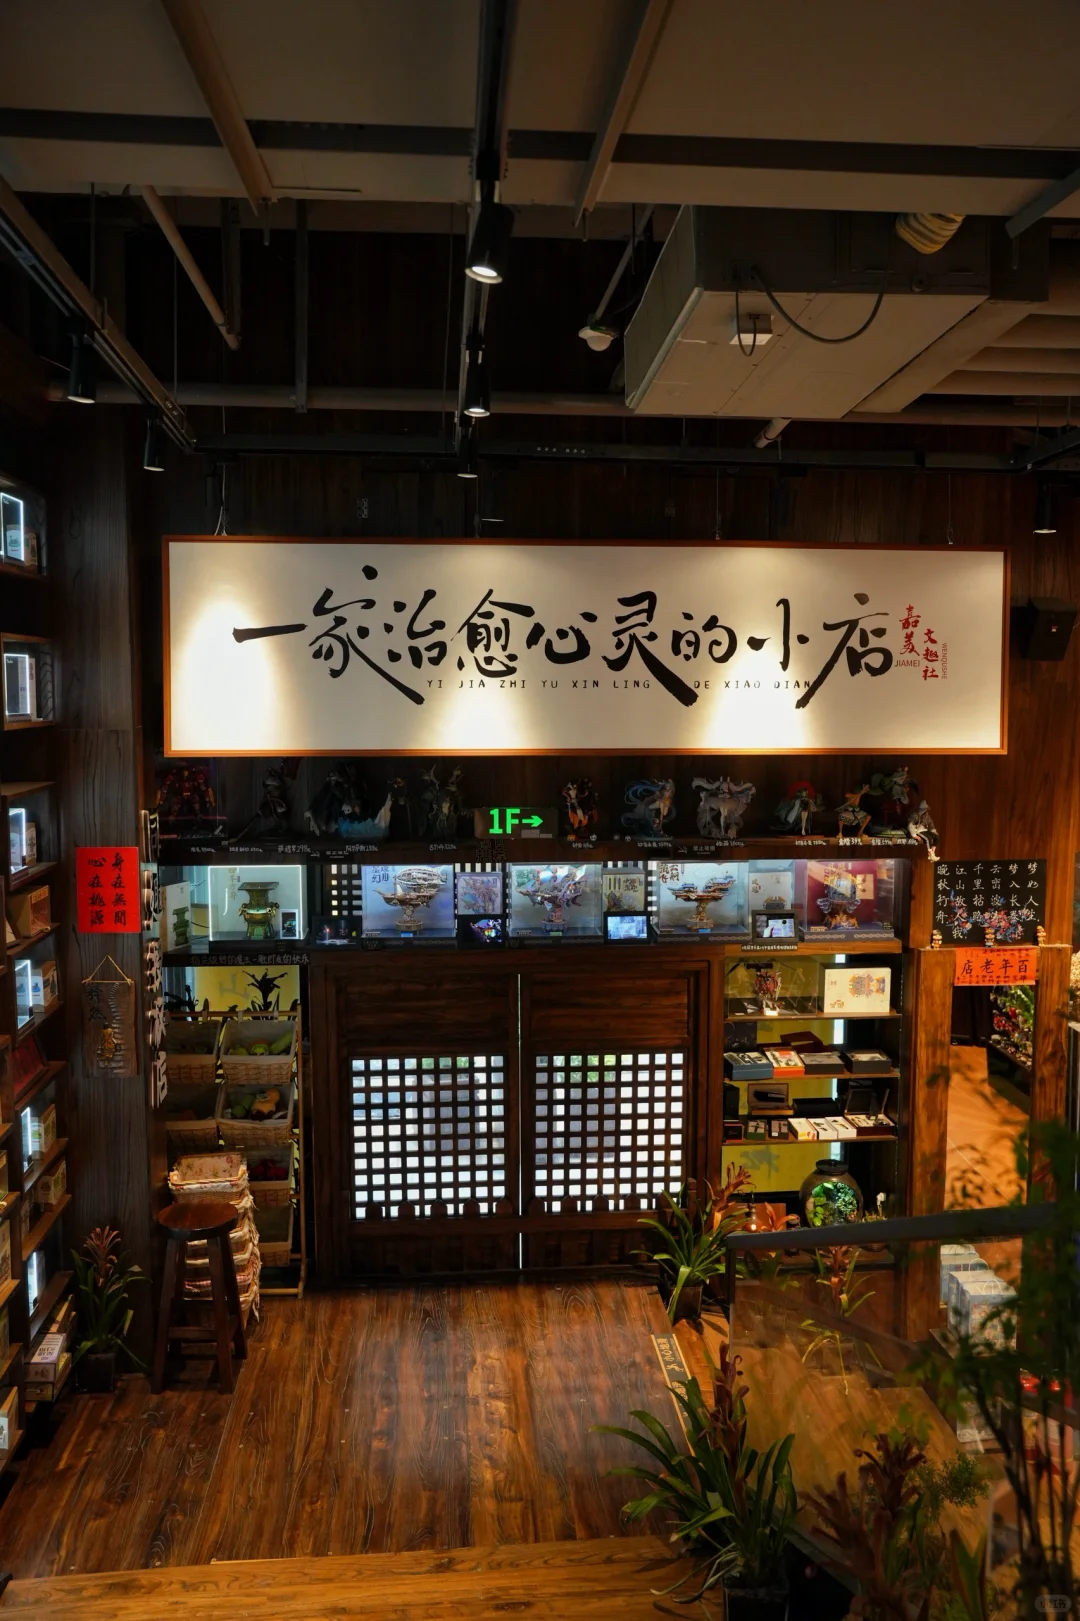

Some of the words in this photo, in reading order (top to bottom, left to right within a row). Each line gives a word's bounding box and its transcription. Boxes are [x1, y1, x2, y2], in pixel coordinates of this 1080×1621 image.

[232, 565, 894, 709] 一家治愈心灵的小店
[894, 659, 921, 668] JIAMEI
[922, 628, 939, 681] 文趣社
[427, 679, 443, 689] YI
[458, 679, 486, 689] JIA
[499, 679, 526, 689] ZHI
[542, 679, 558, 689] YU
[572, 679, 599, 689] XIN
[613, 679, 650, 689] LING
[724, 679, 761, 689] XIAO
[774, 679, 811, 689] DIAN
[489, 808, 521, 834] 1F
[961, 958, 1029, 975] 百年老店
